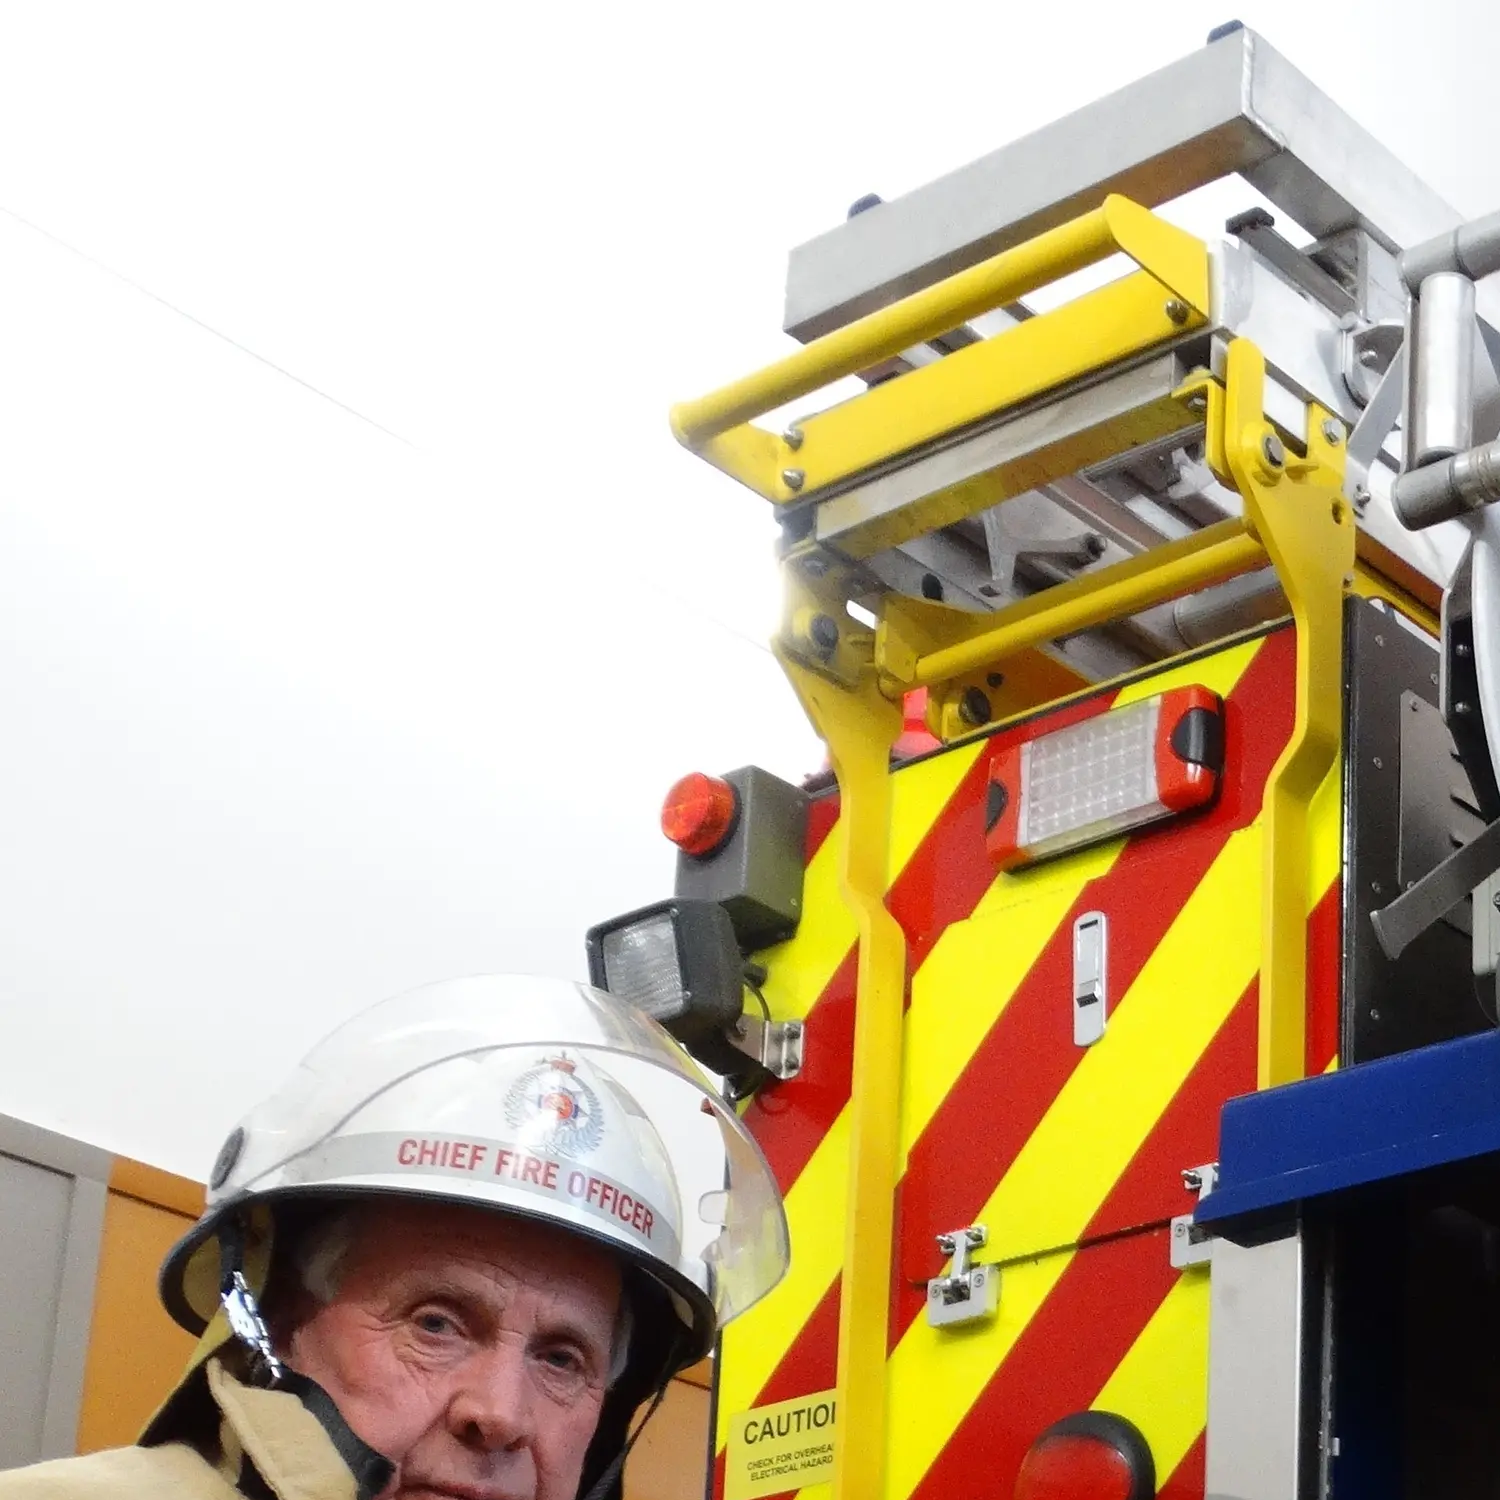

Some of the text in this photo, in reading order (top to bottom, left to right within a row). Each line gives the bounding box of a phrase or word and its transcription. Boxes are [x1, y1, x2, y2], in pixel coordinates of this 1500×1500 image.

[397, 1139, 654, 1239] CHIEF FIRE OFFICER
[743, 1401, 836, 1445] CAUTIO
[747, 1443, 834, 1471] CHECK FOR OVERHEA
[750, 1464, 798, 1481] ELECTRICAL
